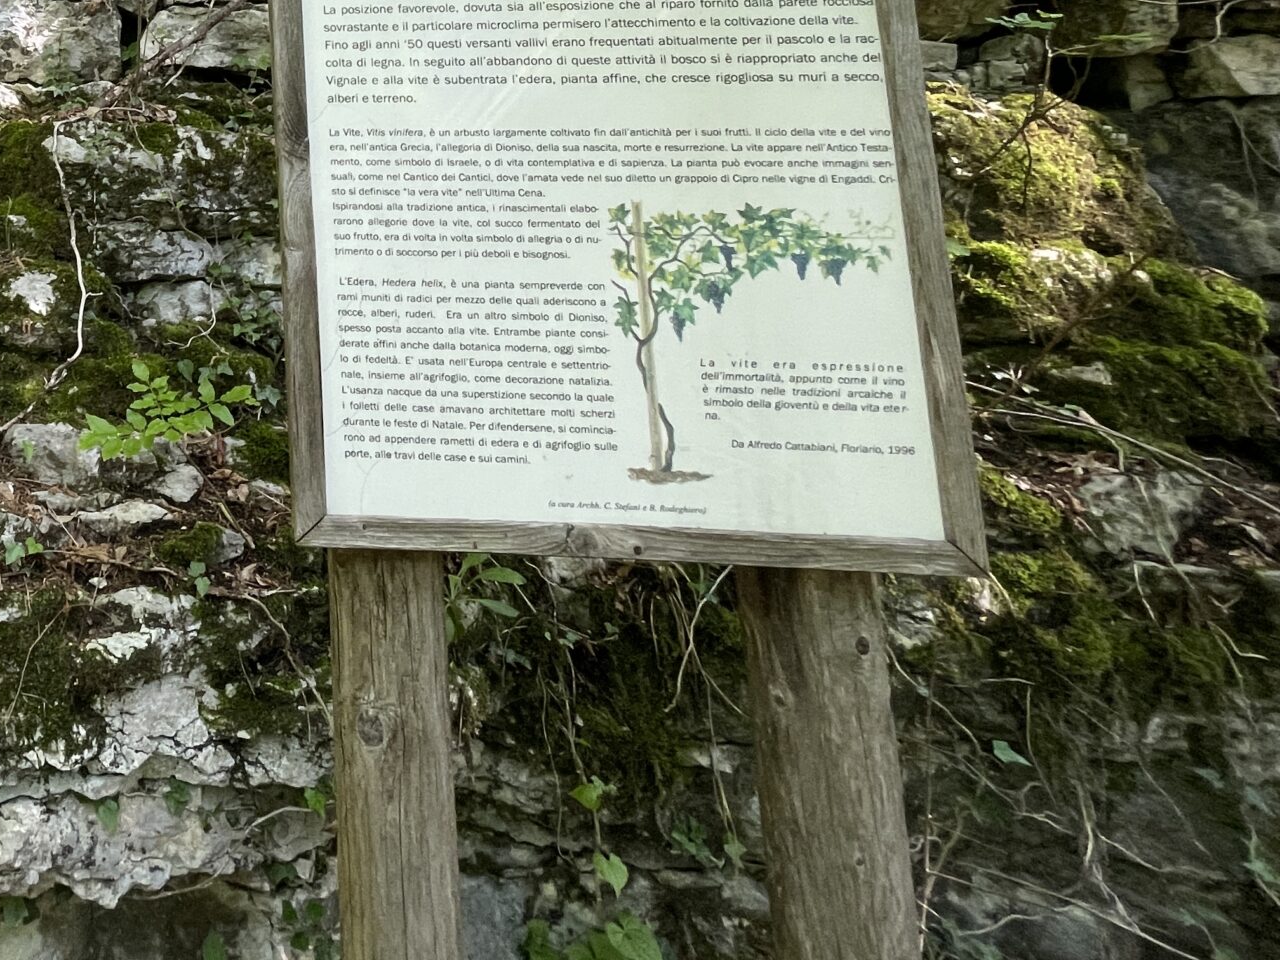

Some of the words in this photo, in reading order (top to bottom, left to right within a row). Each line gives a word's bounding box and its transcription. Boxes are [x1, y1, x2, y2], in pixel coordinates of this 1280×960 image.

[339, 276, 377, 287] L'Edera,
[381, 277, 416, 287] Hedera
[420, 278, 446, 289] helix,
[450, 278, 456, 288] è
[484, 280, 515, 290] pianta
[519, 281, 583, 291] sempreverde
[587, 283, 605, 291] con
[699, 357, 715, 367] La
[730, 358, 758, 368] vite
[772, 361, 796, 369] era
[811, 362, 904, 373] espressione
[700, 371, 784, 383] dell'immortalità,
[788, 375, 832, 384] appunto
[837, 376, 867, 385] come
[871, 375, 878, 385] il
[701, 384, 708, 393] è
[715, 384, 754, 394] rimasto
[760, 386, 785, 395] nelle
[792, 387, 840, 397] tradizioni
[847, 389, 893, 399] arcaiche
[899, 390, 906, 399] il
[703, 397, 744, 407] simbolo
[746, 399, 771, 408] della
[774, 399, 819, 411] gioventù
[831, 401, 857, 411] della
[860, 403, 880, 412] vita
[704, 412, 720, 420] na.
[731, 438, 744, 448] Da
[746, 440, 782, 450] Alfredo
[784, 441, 838, 453] Cattabiani,
[887, 445, 916, 455] 1996
